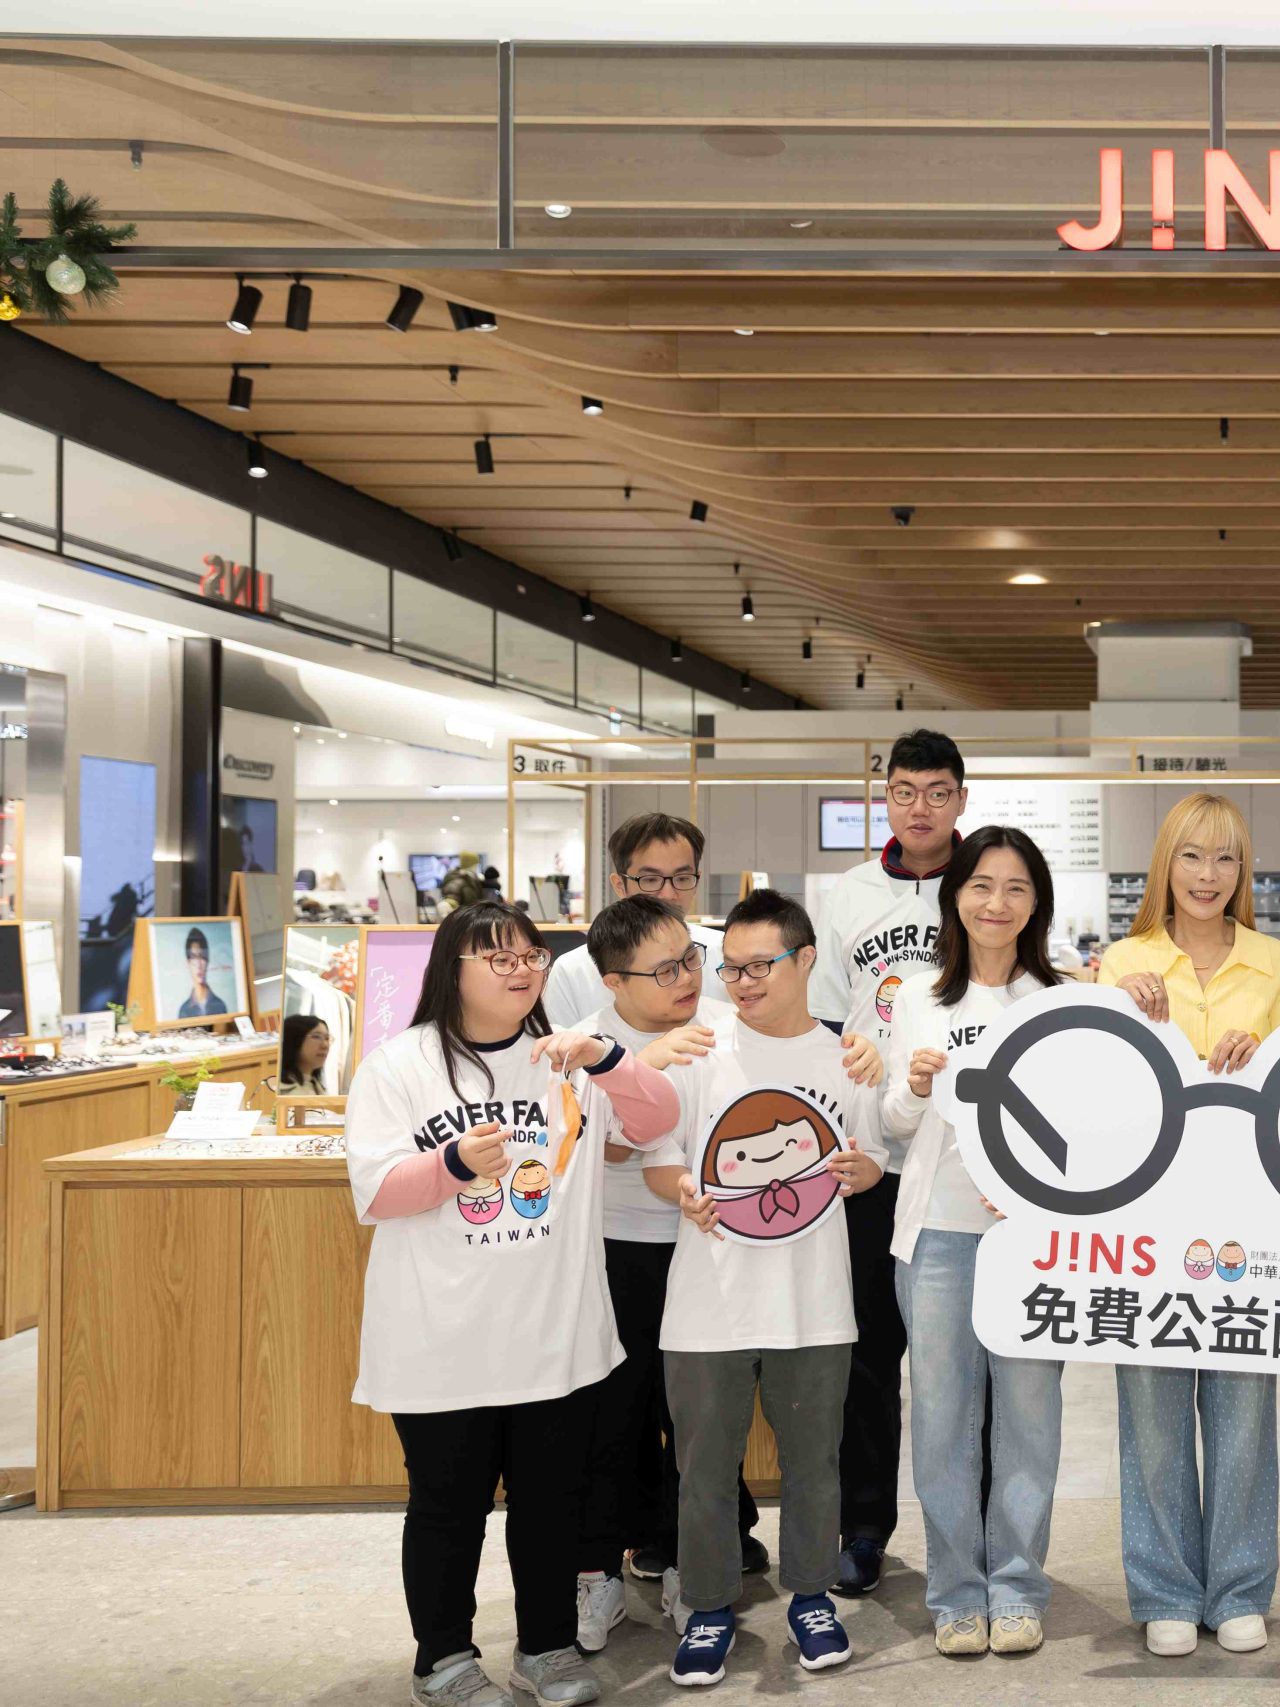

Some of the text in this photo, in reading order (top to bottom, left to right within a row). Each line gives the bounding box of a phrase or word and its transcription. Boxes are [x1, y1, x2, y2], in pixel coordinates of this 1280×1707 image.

[513, 755, 526, 773] 3
[871, 755, 882, 772] 2
[1136, 754, 1144, 772] 1
[853, 924, 918, 972] NEVER
[413, 1101, 507, 1152] NEVER
[465, 1225, 551, 1245] TAIWAN
